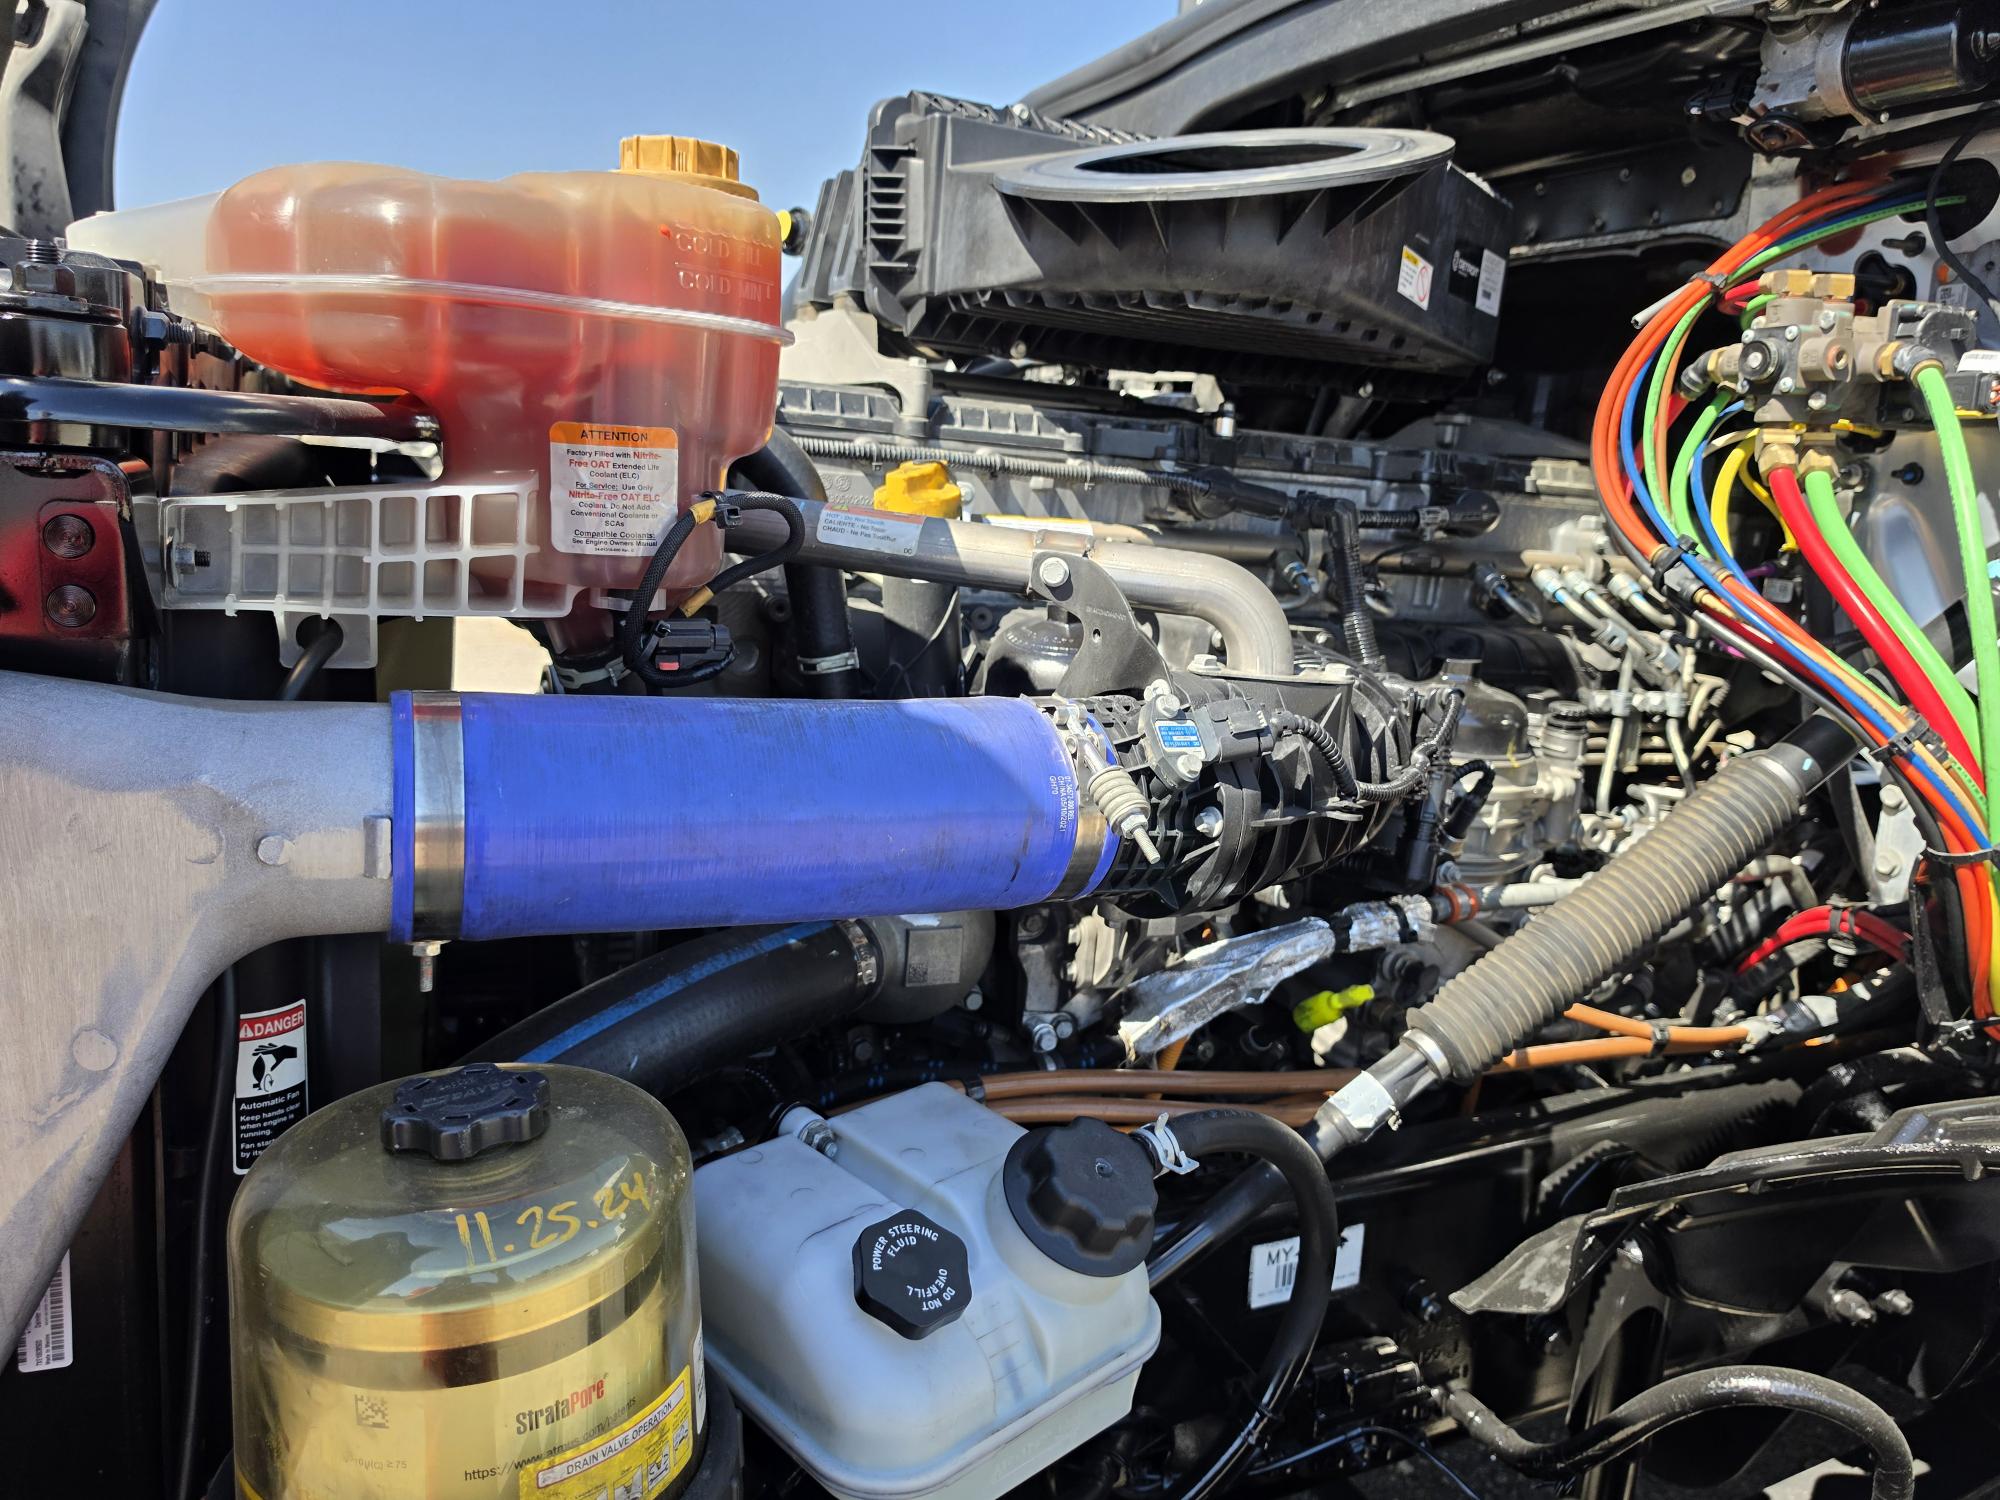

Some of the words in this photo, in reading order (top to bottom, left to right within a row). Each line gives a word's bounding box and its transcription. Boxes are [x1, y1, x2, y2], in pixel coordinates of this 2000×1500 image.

[580, 430, 648, 442] ATTENTION
[567, 449, 592, 458] Factory
[595, 450, 614, 458] Filled
[633, 451, 662, 460] Nitrite-
[569, 459, 588, 468] Free
[590, 460, 611, 468] OAT
[612, 462, 645, 471] Extended
[590, 471, 618, 479] Coolant
[619, 472, 640, 480] (ELC)
[575, 481, 587, 490] For
[637, 484, 654, 492] Only
[568, 490, 618, 501] Nitrite-Free
[621, 492, 641, 501] OAT
[643, 493, 660, 502] ELC
[610, 502, 620, 510] Do
[570, 509, 617, 518] Conventional
[618, 511, 650, 519] Coolants
[824, 519, 855, 529] CALIENTE
[574, 529, 617, 539] Compatible
[620, 531, 656, 539] Coolants:
[822, 525, 845, 534] CHAUD
[860, 530, 871, 538] Pas
[585, 539, 608, 547] Engine
[1049, 775, 1059, 795] GH70
[1057, 775, 1067, 797] CHINA
[254, 1010, 304, 1037] DANGER
[240, 1096, 285, 1111] Automatic
[287, 1090, 300, 1100] Fan
[240, 1114, 261, 1122] Keep
[262, 1108, 285, 1118] hands
[286, 1102, 300, 1112] clear
[240, 1122, 261, 1130] when
[263, 1116, 287, 1127] engine
[240, 1129, 272, 1138] running.
[240, 1142, 255, 1150] Fan
[257, 1139, 275, 1148] star
[240, 1151, 251, 1159] by
[455, 1171, 650, 1269] 11.25.24
[872, 1236, 888, 1271] POWER
[888, 1224, 939, 1242] STEERING
[887, 1236, 917, 1257] FLUID
[906, 1268, 948, 1298] OVERFILL
[942, 1286, 955, 1301] DO
[922, 1298, 943, 1311] NOT
[515, 1378, 606, 1436] StrataPore
[566, 1452, 600, 1476] DRAIN
[600, 1436, 630, 1460] VALVE
[631, 1400, 673, 1442] OPERATION
